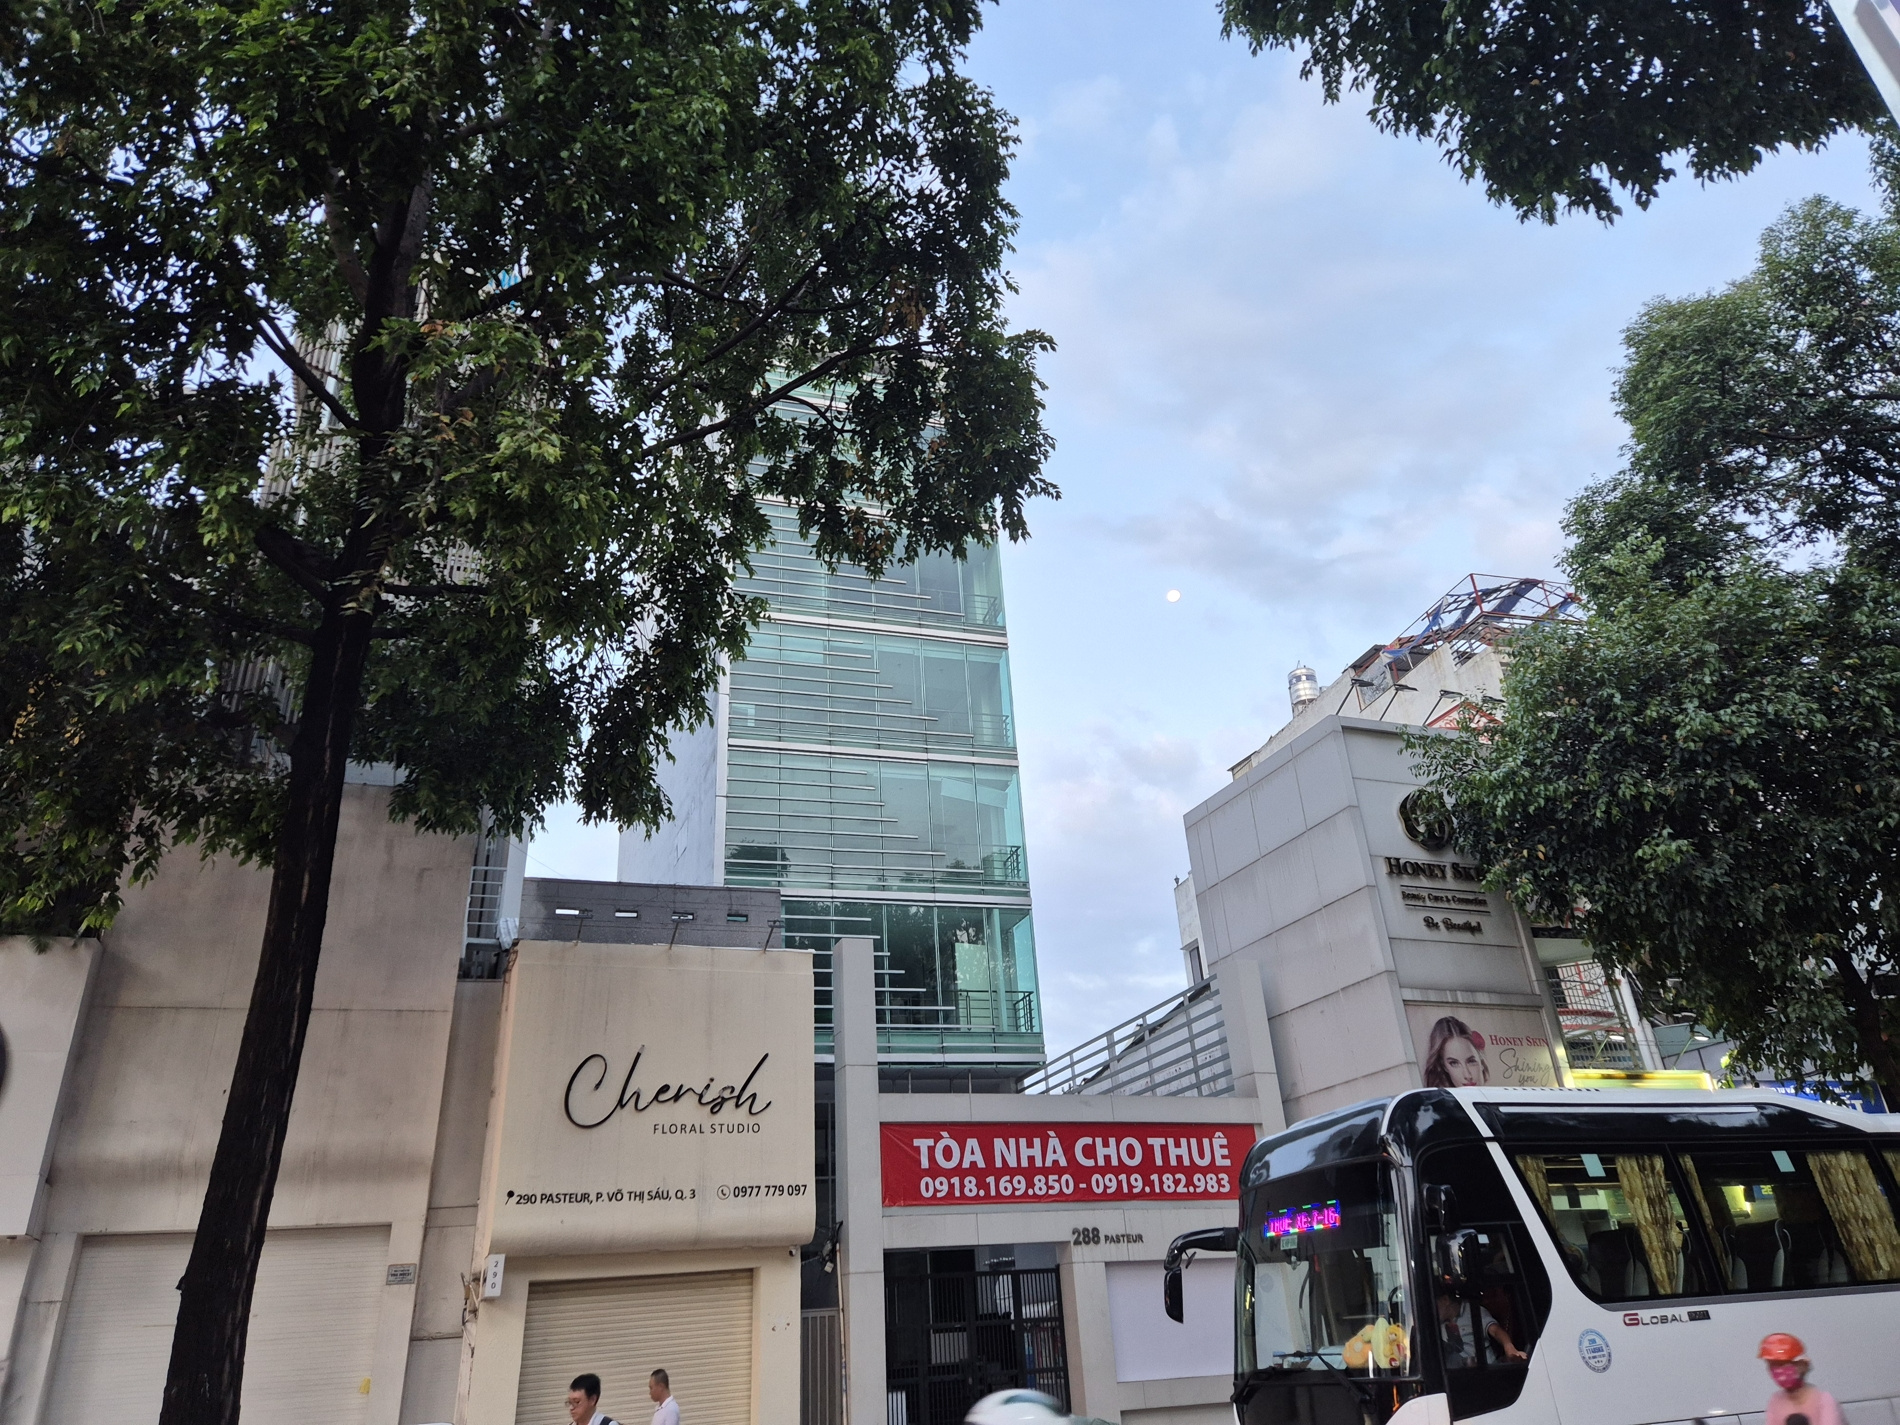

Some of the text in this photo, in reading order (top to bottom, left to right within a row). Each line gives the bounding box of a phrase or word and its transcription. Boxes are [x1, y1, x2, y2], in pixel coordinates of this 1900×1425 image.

[1385, 857, 1447, 879] HONEY
[1489, 1034, 1549, 1047] HONEY SKIN
[1499, 1047, 1551, 1087] Shining
[564, 1044, 772, 1129] Cherish
[652, 1122, 762, 1135] FLORAL STUDIO
[912, 1130, 1232, 1170] TÒA NHÀ CHO THUÊ
[515, 1186, 697, 1206] 290 PASTEUR, P. VÕ THỊ SÁU, Q. 3
[733, 1184, 808, 1199] 0977 779 097
[919, 1173, 1075, 1199] 0918.169.850
[1090, 1172, 1231, 1195] 0919.182.983
[1072, 1227, 1144, 1246] 288 PASTEUR
[491, 1261, 499, 1289] 290
[1623, 1313, 1685, 1327] GLOBAL
